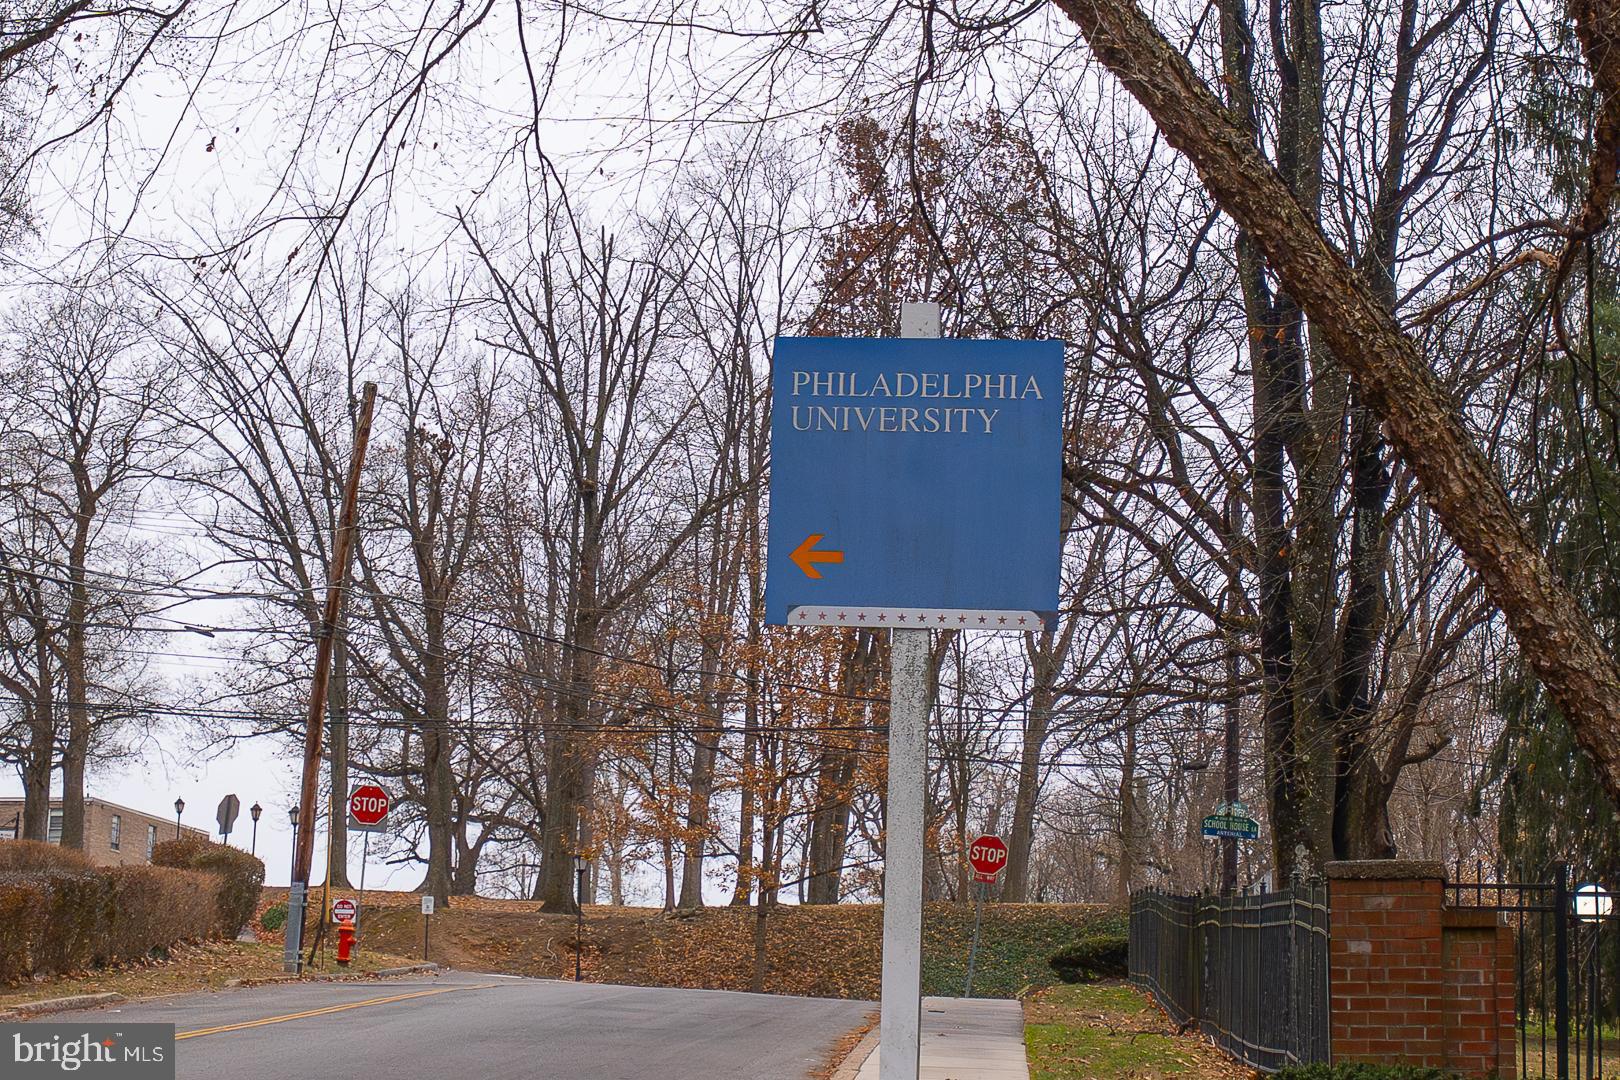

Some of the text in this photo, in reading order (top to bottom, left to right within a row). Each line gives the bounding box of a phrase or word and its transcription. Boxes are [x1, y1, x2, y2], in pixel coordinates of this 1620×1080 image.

[791, 371, 1044, 400] PHILADELPHIA
[791, 405, 1000, 434] UNIVERSITY
[352, 796, 387, 813] STOP
[1204, 819, 1228, 829] SCHOOL
[1229, 822, 1249, 832] HOUSE
[971, 846, 1006, 864] STOP
